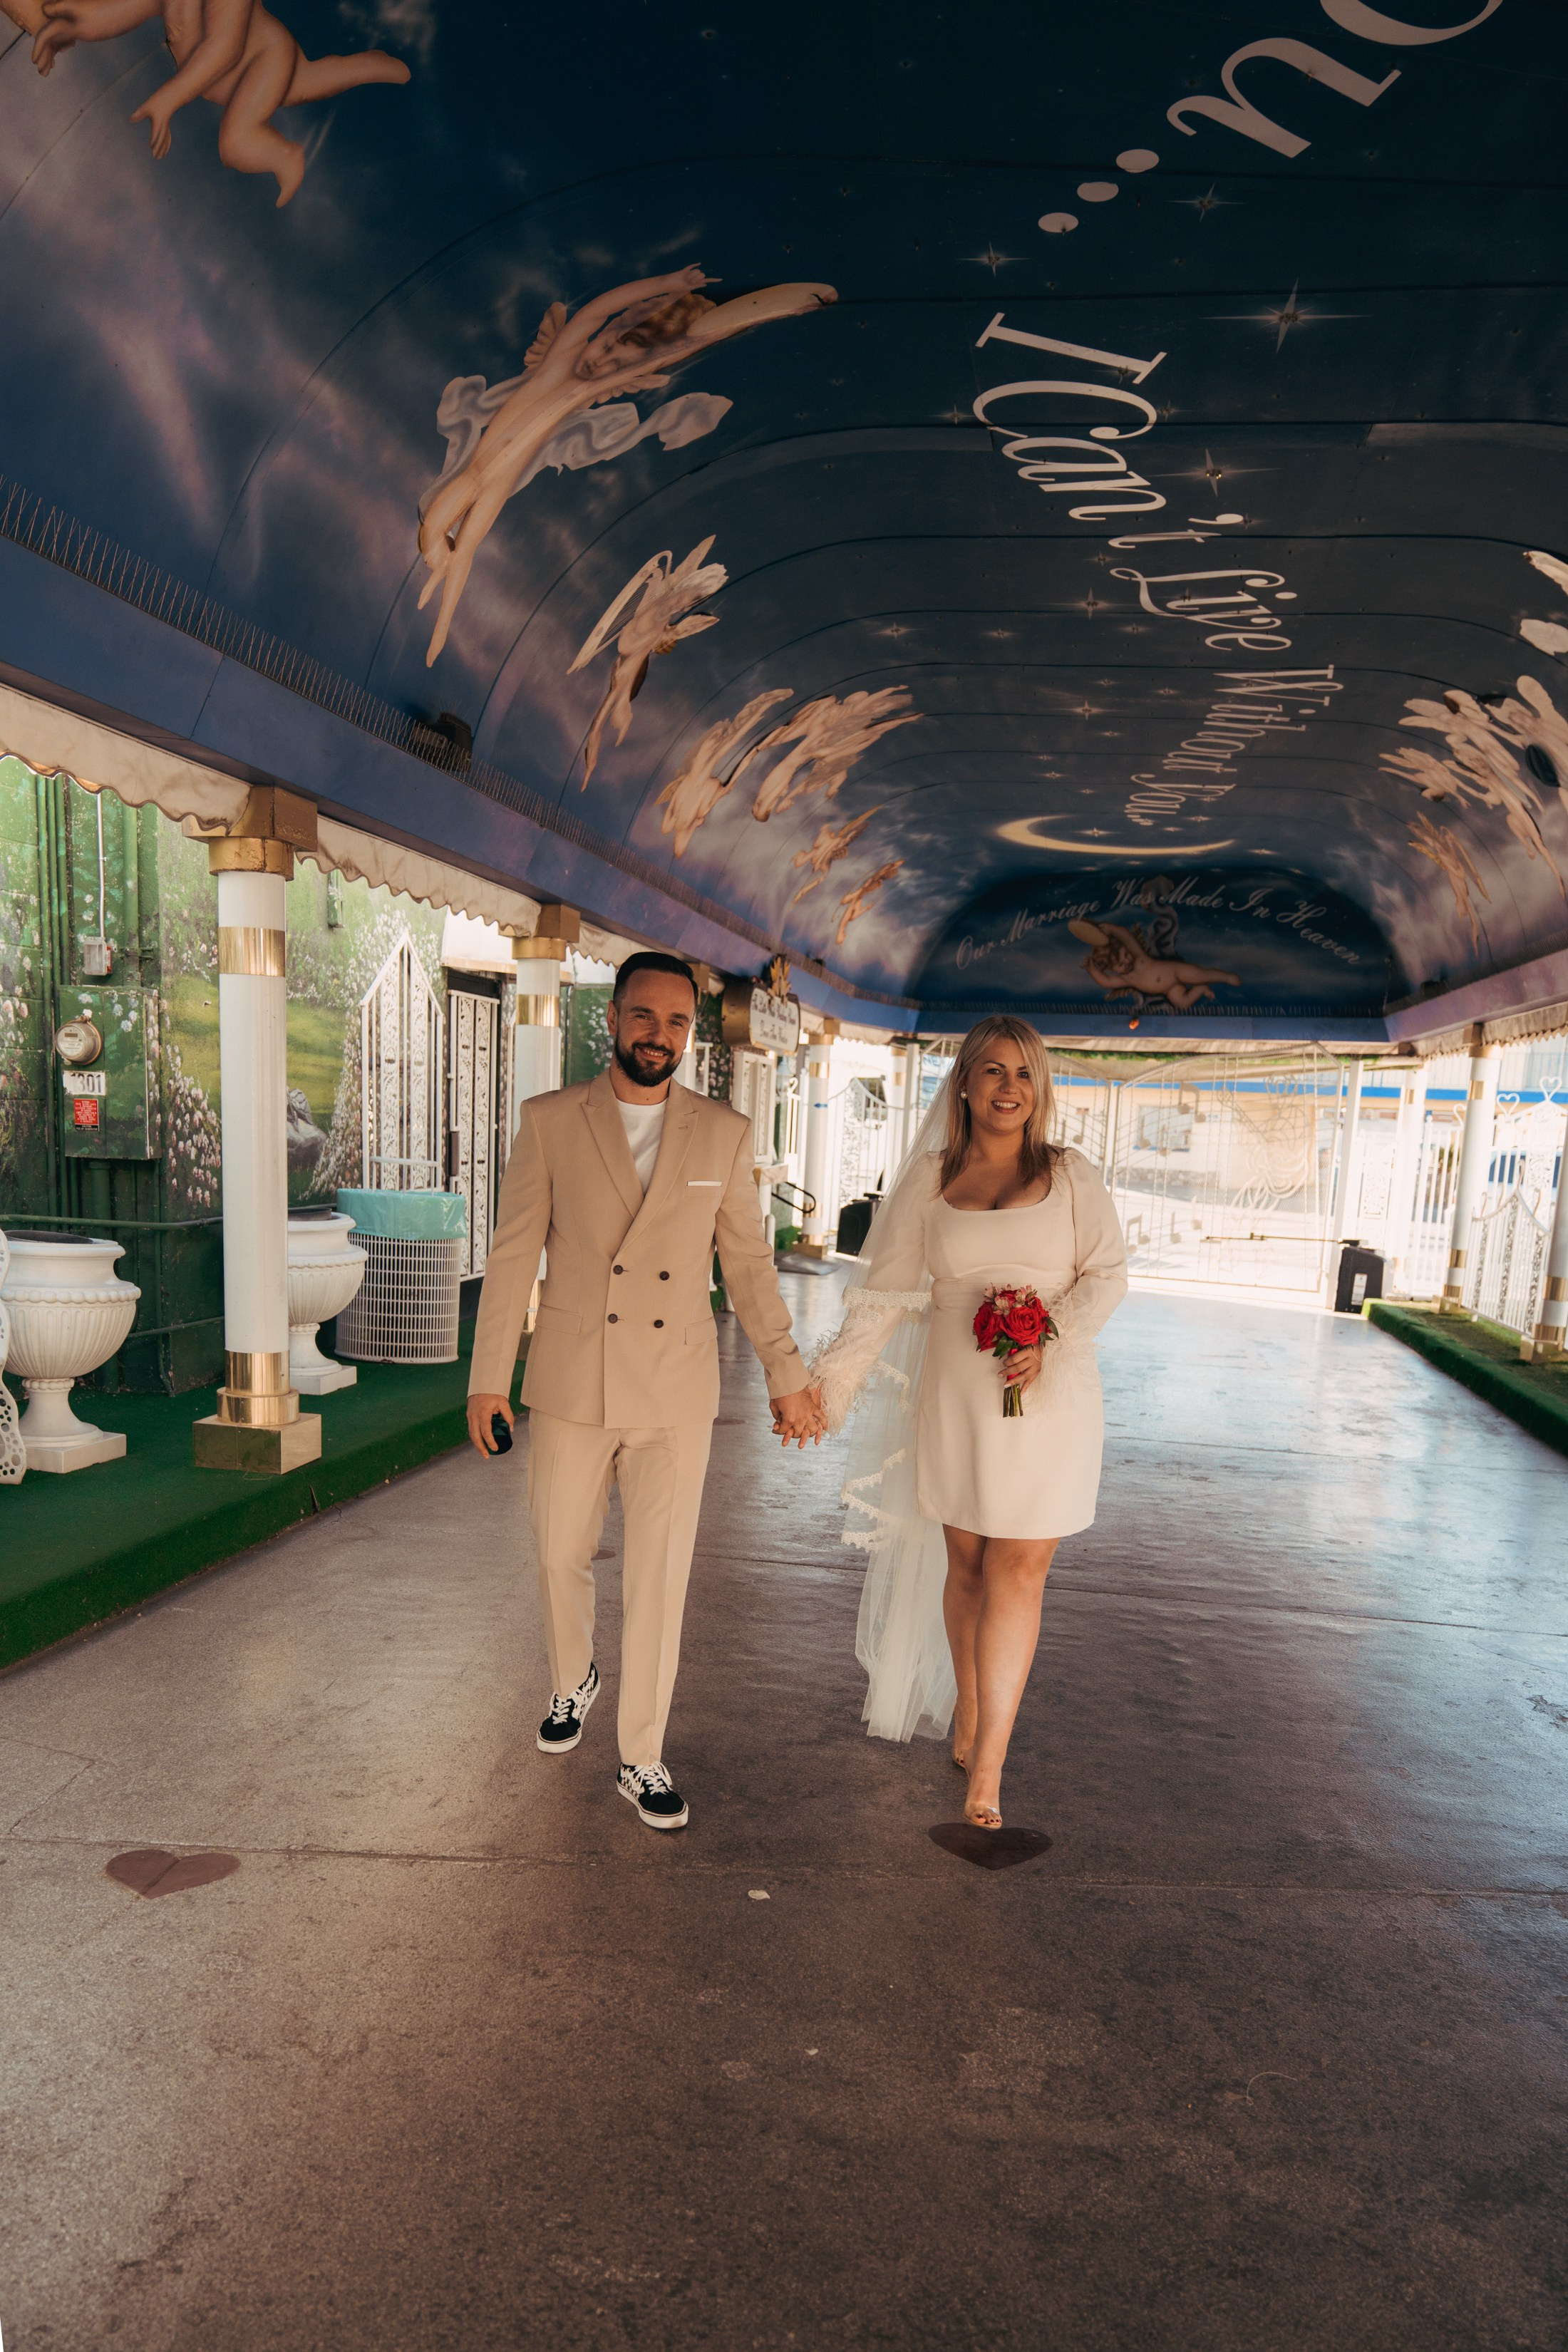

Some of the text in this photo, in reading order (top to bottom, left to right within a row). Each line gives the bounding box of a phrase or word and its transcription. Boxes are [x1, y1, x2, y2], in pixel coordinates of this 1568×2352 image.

[974, 311, 1167, 384] I
[972, 380, 1244, 549] Can't
[1109, 567, 1297, 651] Live
[1161, 664, 1344, 773] Without
[956, 875, 1361, 970] Our Marriage Was Made In Heaven
[71, 1072, 102, 1094] 1301
